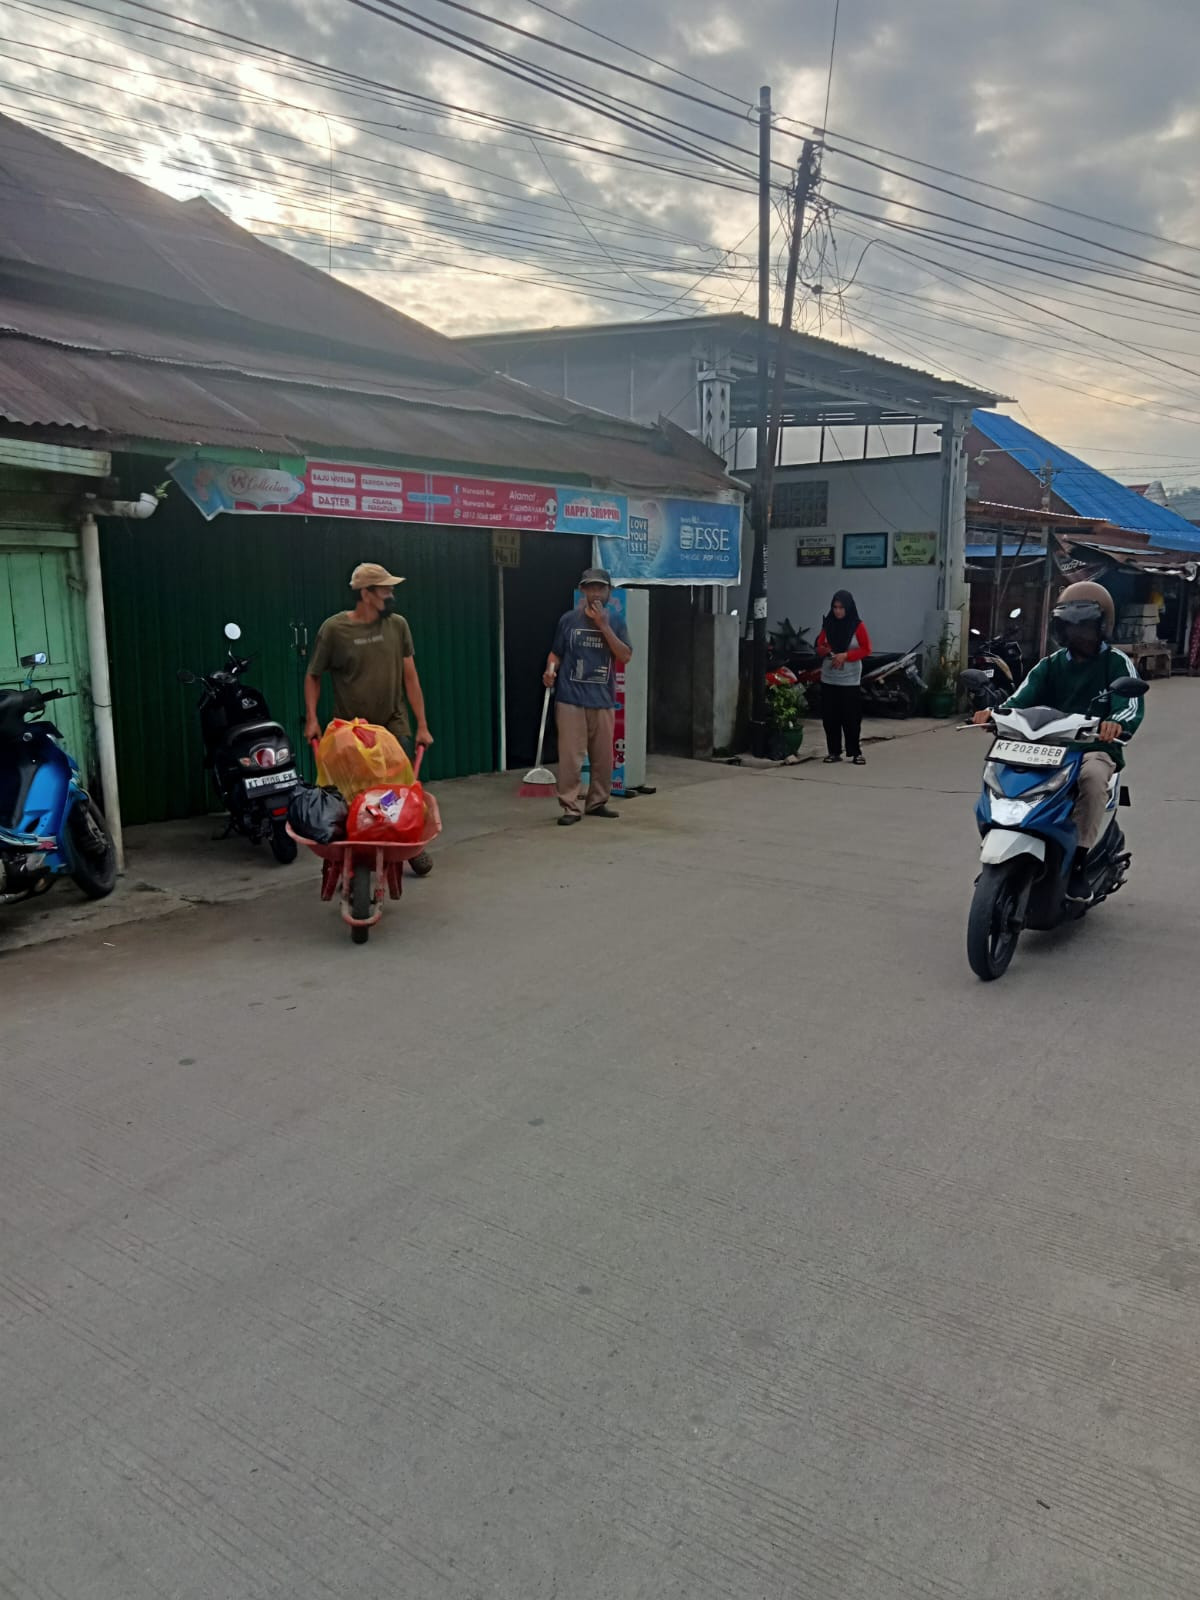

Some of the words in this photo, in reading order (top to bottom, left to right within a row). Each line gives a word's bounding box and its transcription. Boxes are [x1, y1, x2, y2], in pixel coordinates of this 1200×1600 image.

[318, 495, 350, 507] DASTER
[565, 504, 589, 518] HAPPY
[630, 519, 647, 530] LOVE
[630, 531, 647, 541] YOUR
[695, 527, 730, 551] ESSE
[630, 542, 647, 552] SELF
[996, 741, 1012, 751] KT
[1011, 743, 1041, 755] 2026
[1040, 747, 1063, 757] BEB
